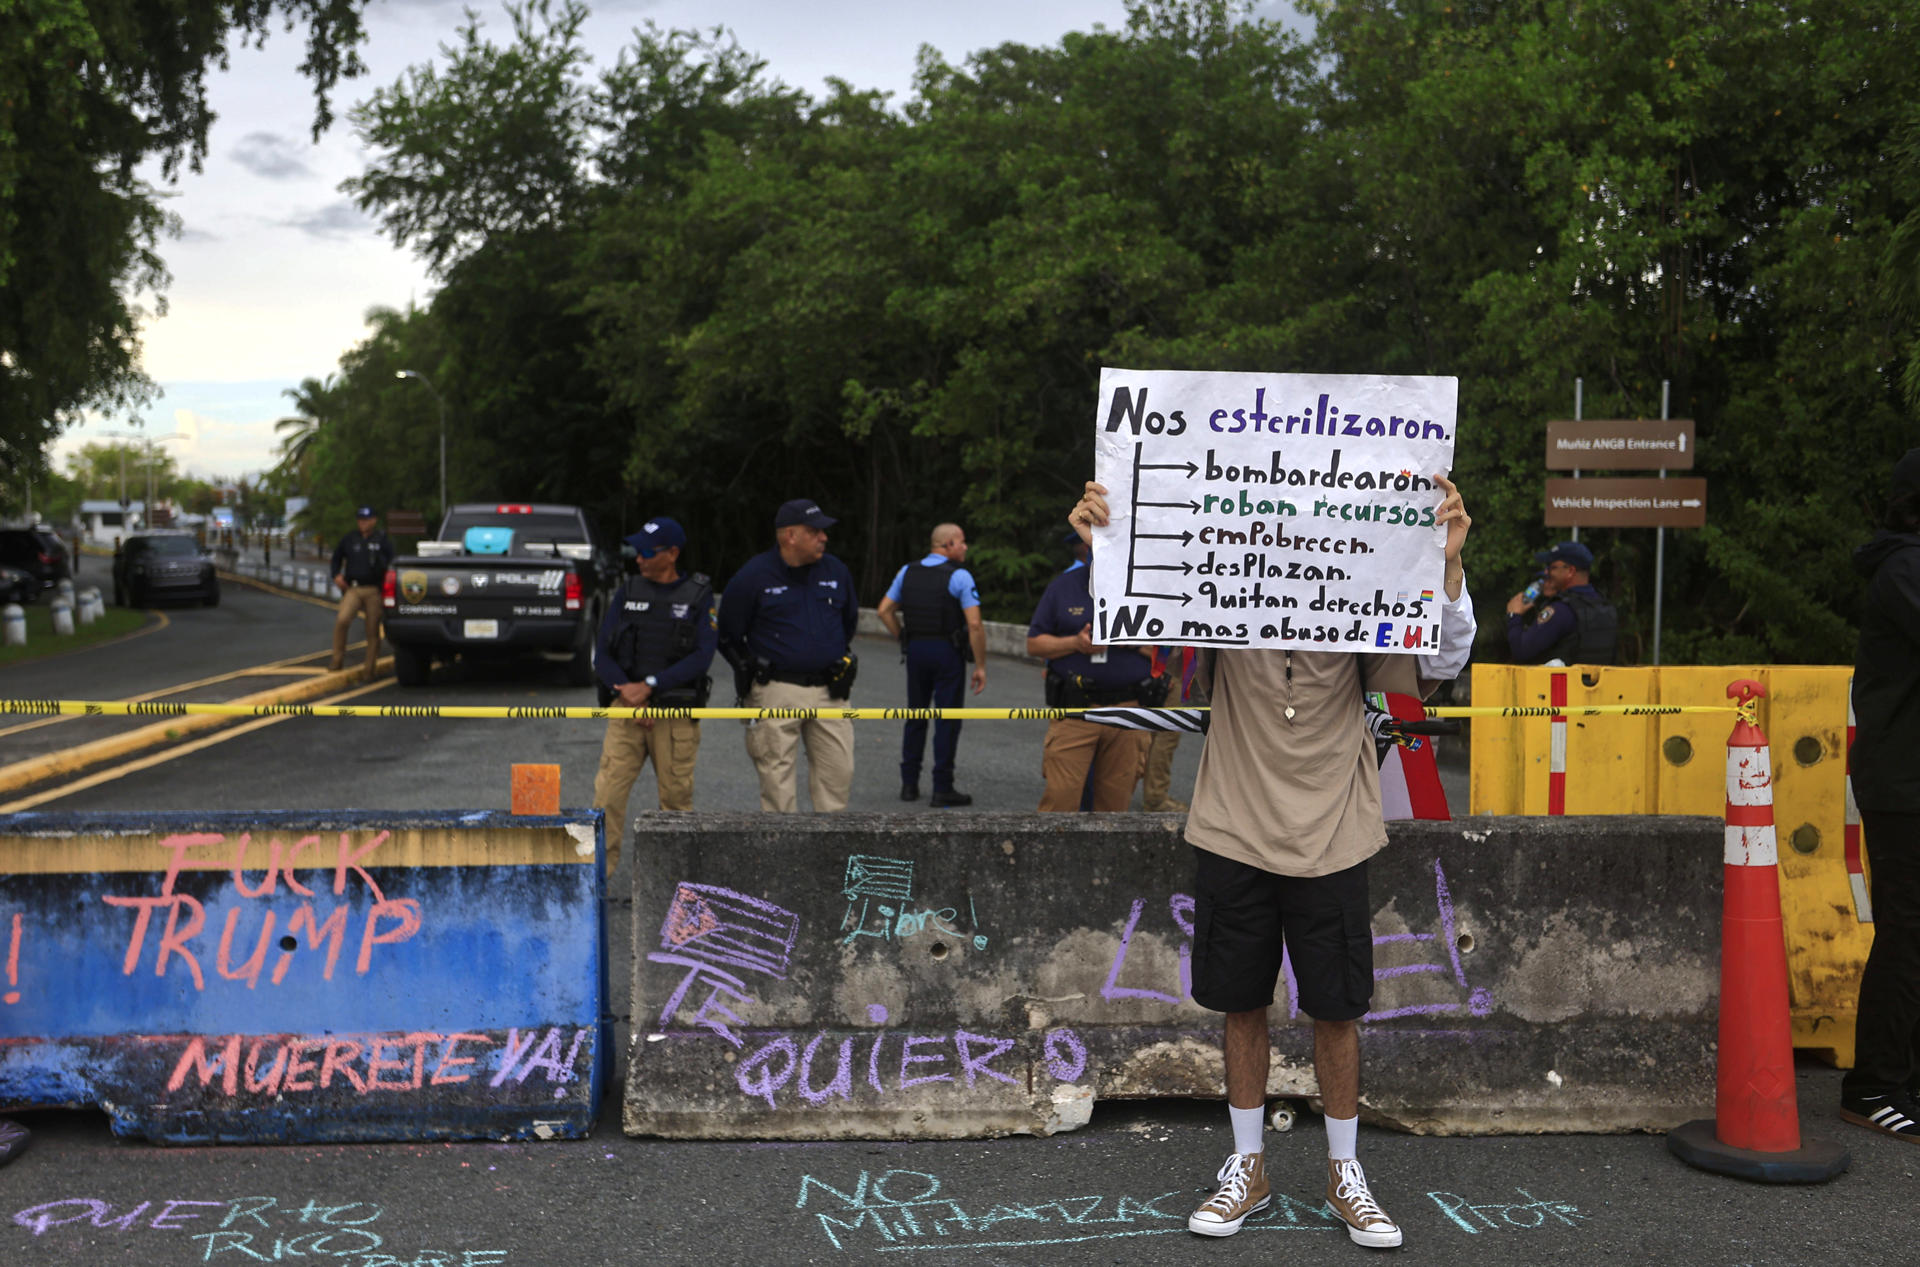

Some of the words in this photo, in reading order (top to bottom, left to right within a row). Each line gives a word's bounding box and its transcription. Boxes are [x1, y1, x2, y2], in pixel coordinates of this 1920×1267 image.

[1105, 386, 1187, 436] Nos
[1209, 388, 1451, 440] esterilizaron.
[1627, 438, 1676, 450] Entrance
[1203, 490, 1298, 517] roban
[1552, 497, 1591, 509] Vehicle
[1593, 497, 1651, 511] Inspection
[1653, 497, 1680, 509] Lane
[1199, 581, 1298, 609] quitan
[1309, 585, 1428, 619] derechos.
[1181, 619, 1249, 638] mas
[1260, 617, 1339, 643] abuso
[1344, 620, 1369, 643] de
[633, 707, 692, 719] CAUTION
[759, 708, 818, 719] CAUTION
[884, 708, 943, 719] CAUTION
[158, 829, 390, 903] FUCK
[102, 893, 423, 991] TRUMP
[647, 951, 755, 1049] TE
[168, 1030, 494, 1096] MUERETE
[490, 1026, 587, 1098] YA!
[796, 1169, 940, 1208] NO
[13, 1198, 222, 1236] QUE
